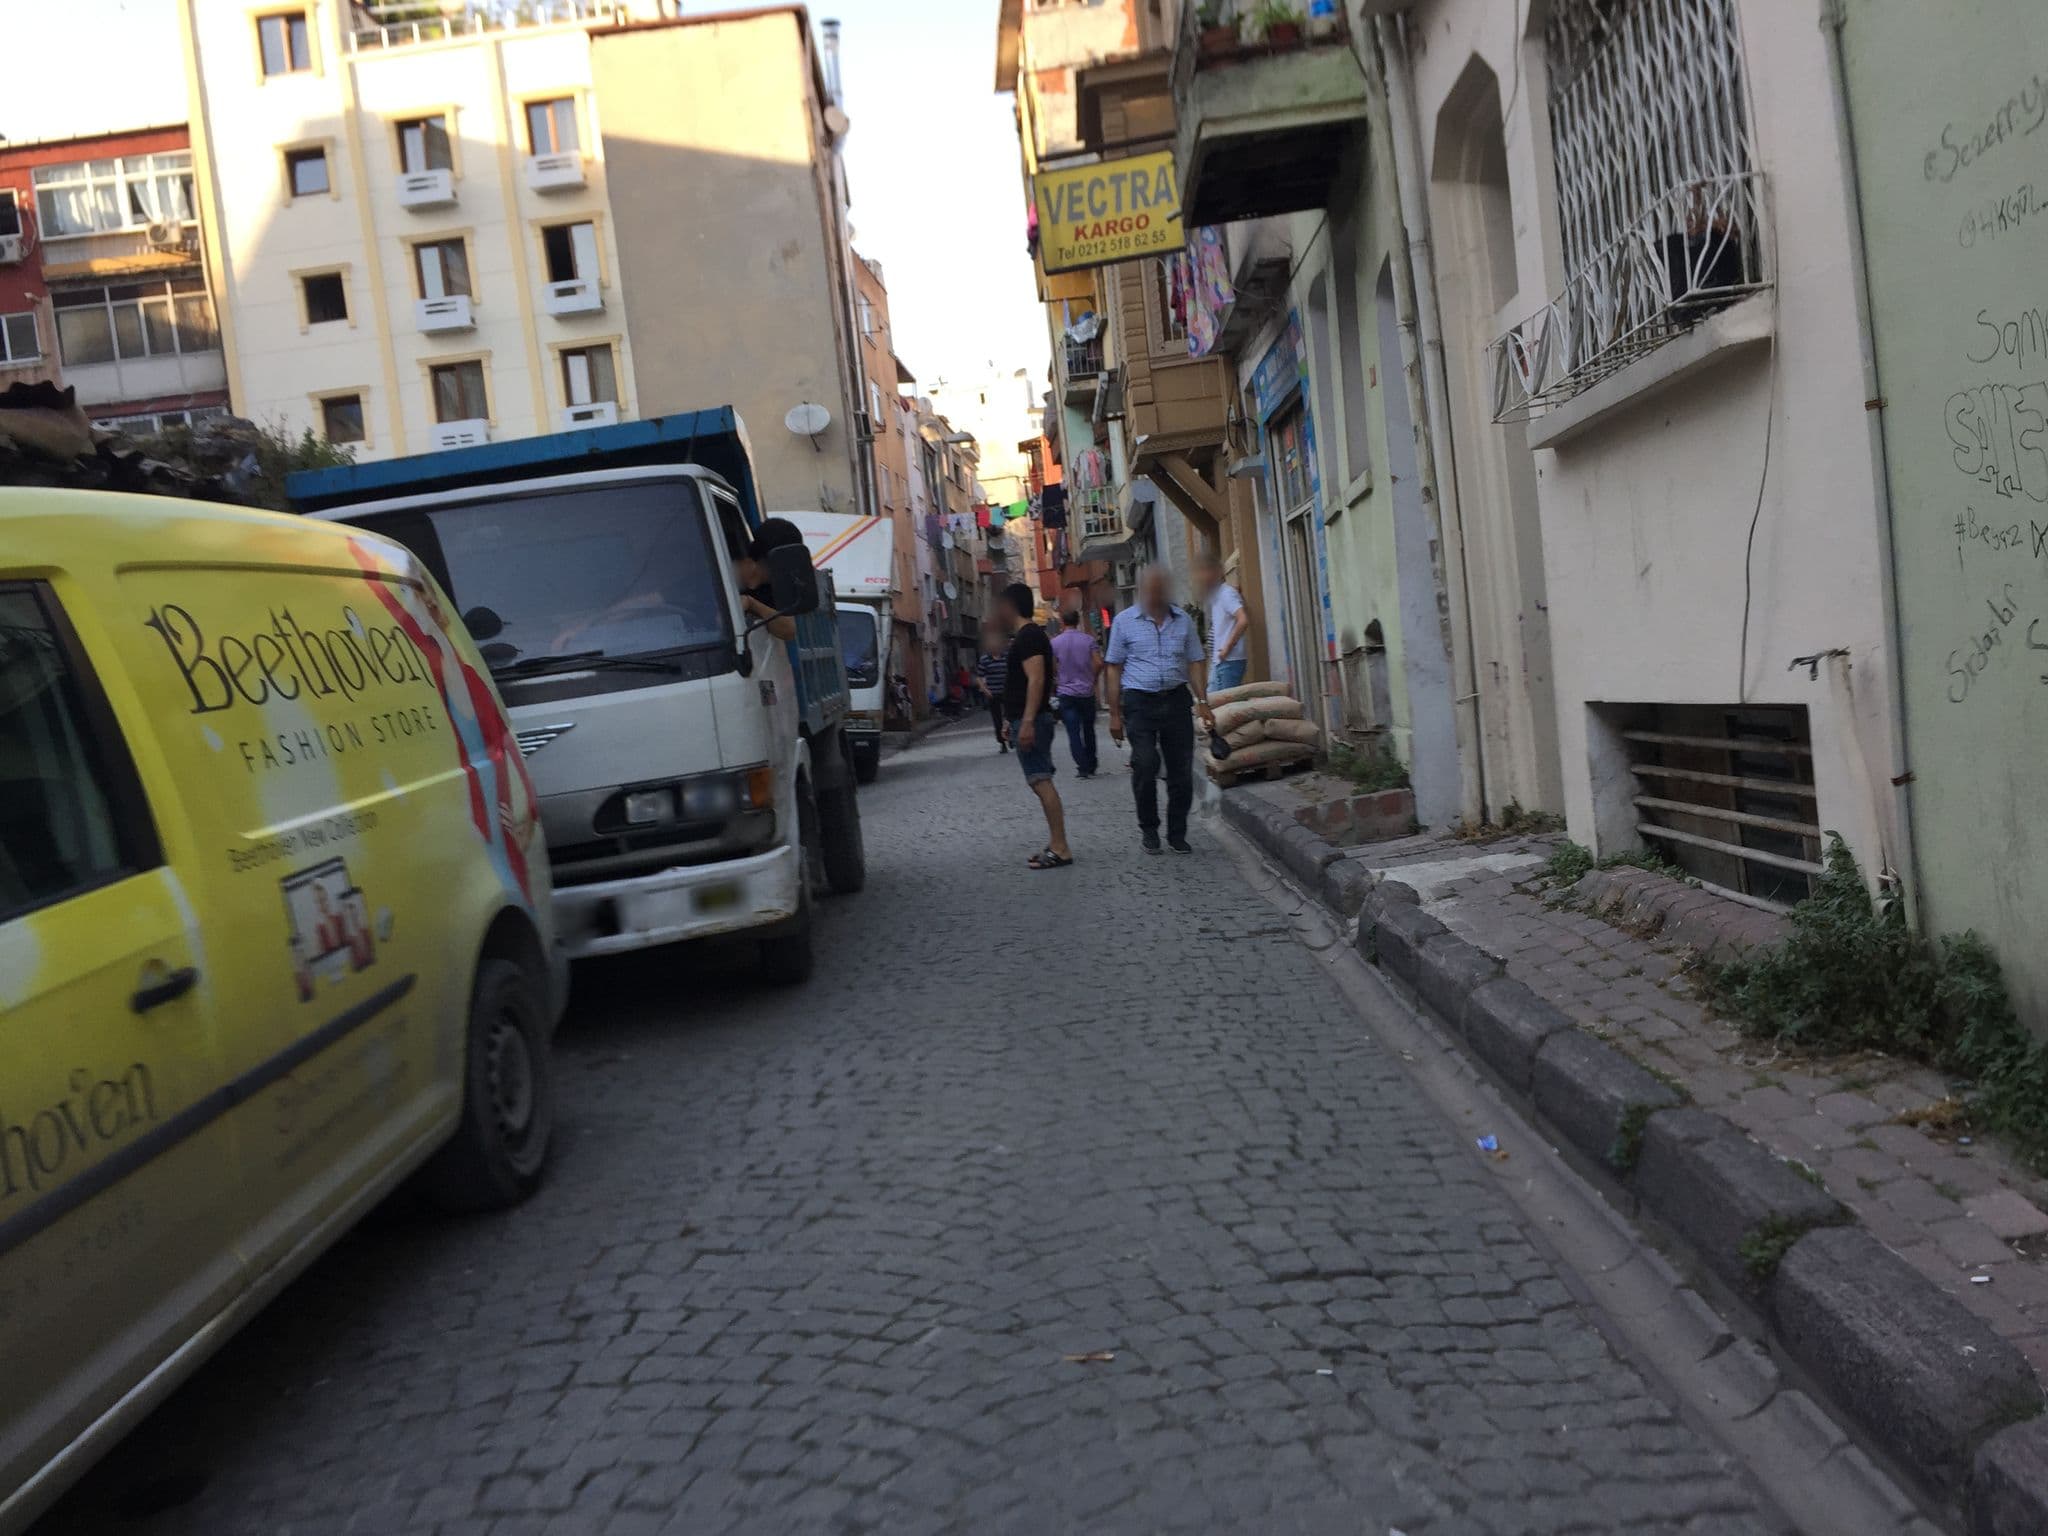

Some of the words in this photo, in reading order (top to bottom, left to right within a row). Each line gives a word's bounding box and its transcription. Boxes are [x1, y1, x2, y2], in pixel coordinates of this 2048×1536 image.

[1042, 164, 1174, 225] VECTRA
[1057, 244, 1075, 261] Tel
[1078, 242, 1107, 257] 0212
[1110, 235, 1131, 251] 518
[1134, 233, 1149, 247] 62
[1152, 230, 1167, 243] 55
[1074, 213, 1150, 242] KARGO
[144, 604, 436, 715] Beethoven
[238, 721, 365, 774] FASHION
[370, 705, 437, 743] STORE
